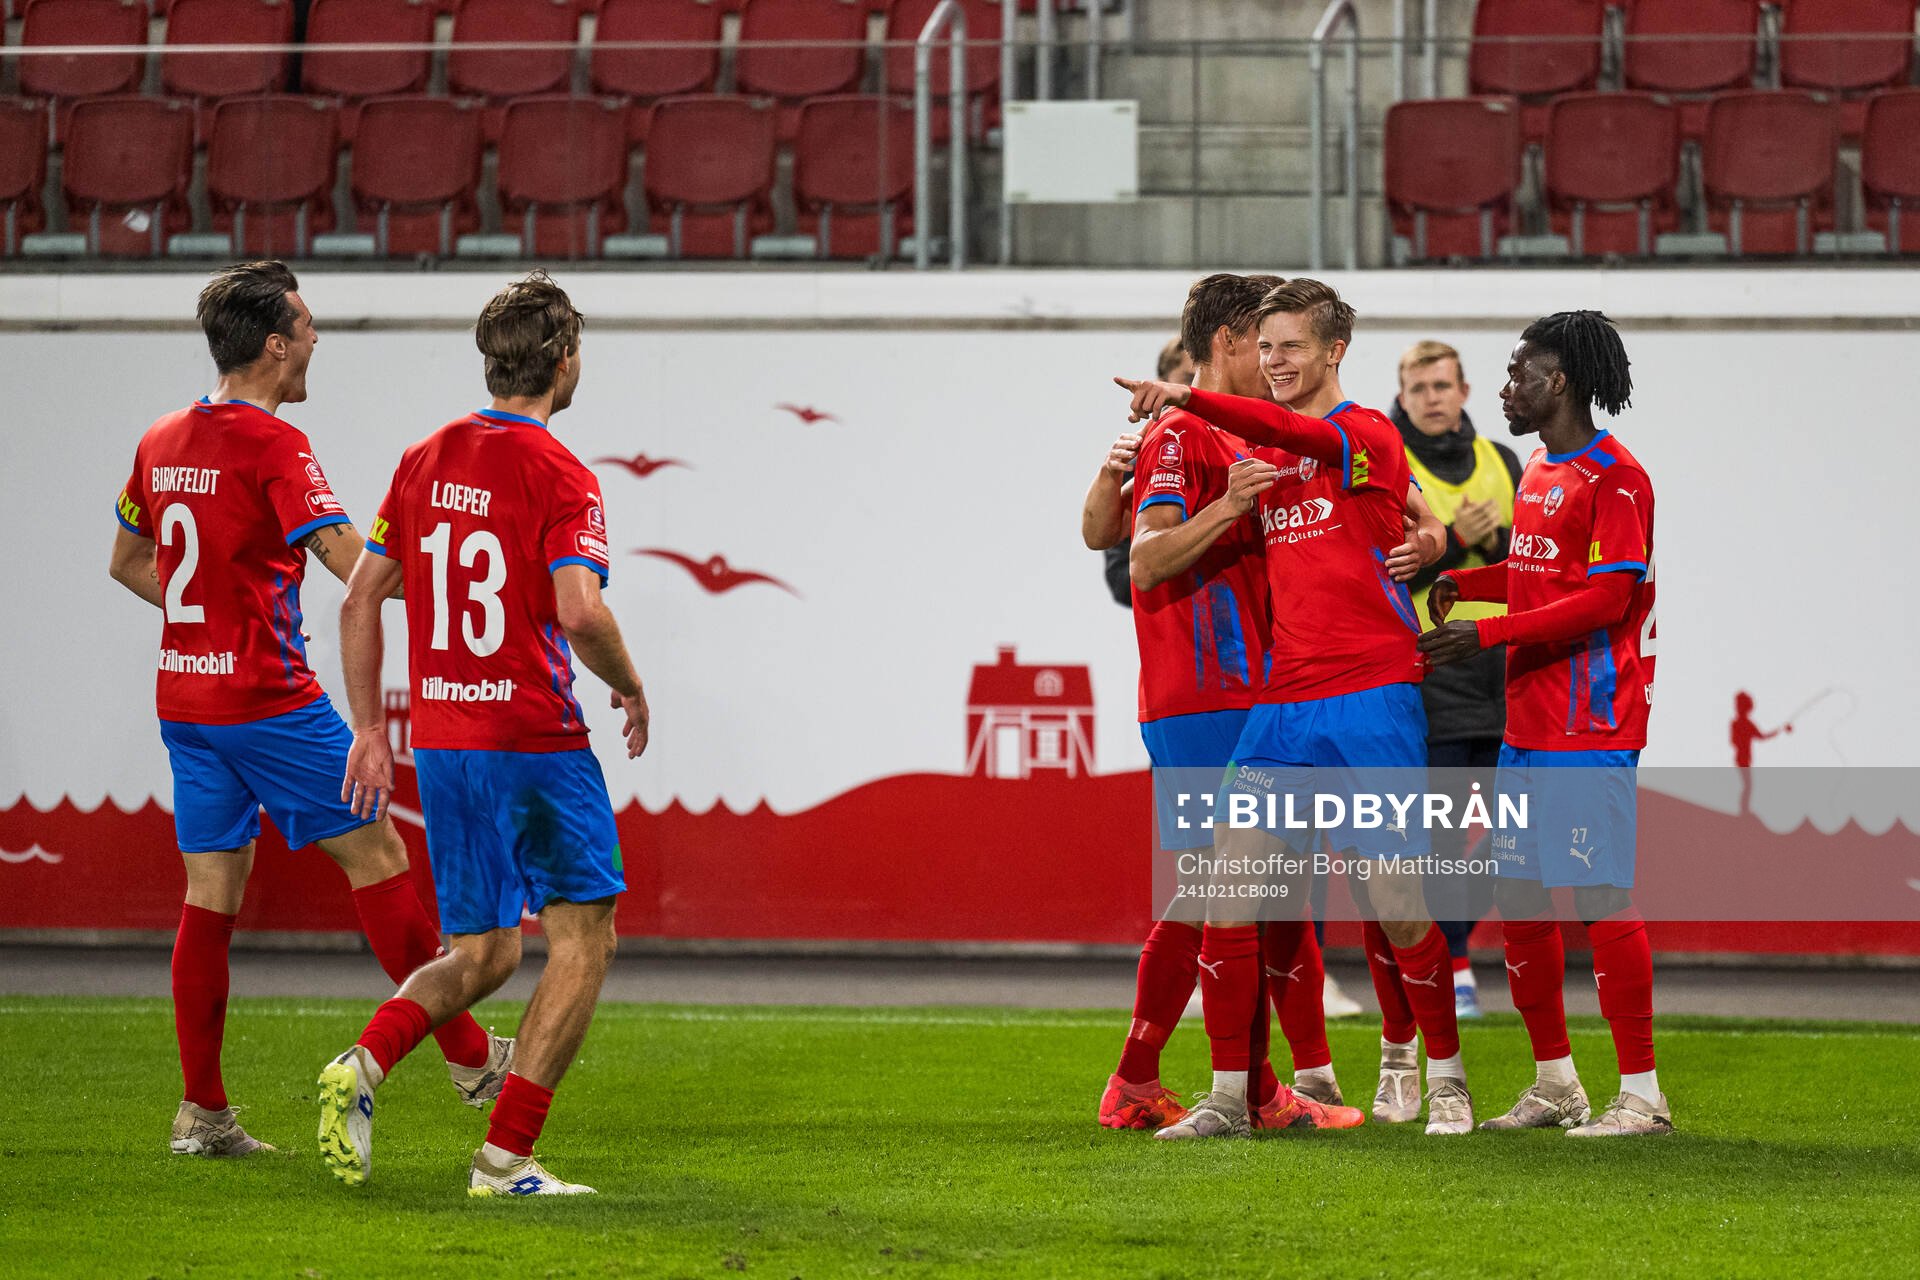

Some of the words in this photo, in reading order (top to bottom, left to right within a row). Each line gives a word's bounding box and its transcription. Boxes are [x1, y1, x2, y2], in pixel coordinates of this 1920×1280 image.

[152, 467, 221, 495] BIRKFELDT
[431, 480, 492, 518] LOEPER
[161, 503, 206, 623] 2
[420, 522, 507, 657] 13
[159, 649, 234, 675] tillmobil
[422, 677, 513, 702] tillmobil
[1237, 765, 1275, 789] Solid
[1492, 833, 1516, 850] Solid
[1571, 828, 1588, 844] 27
